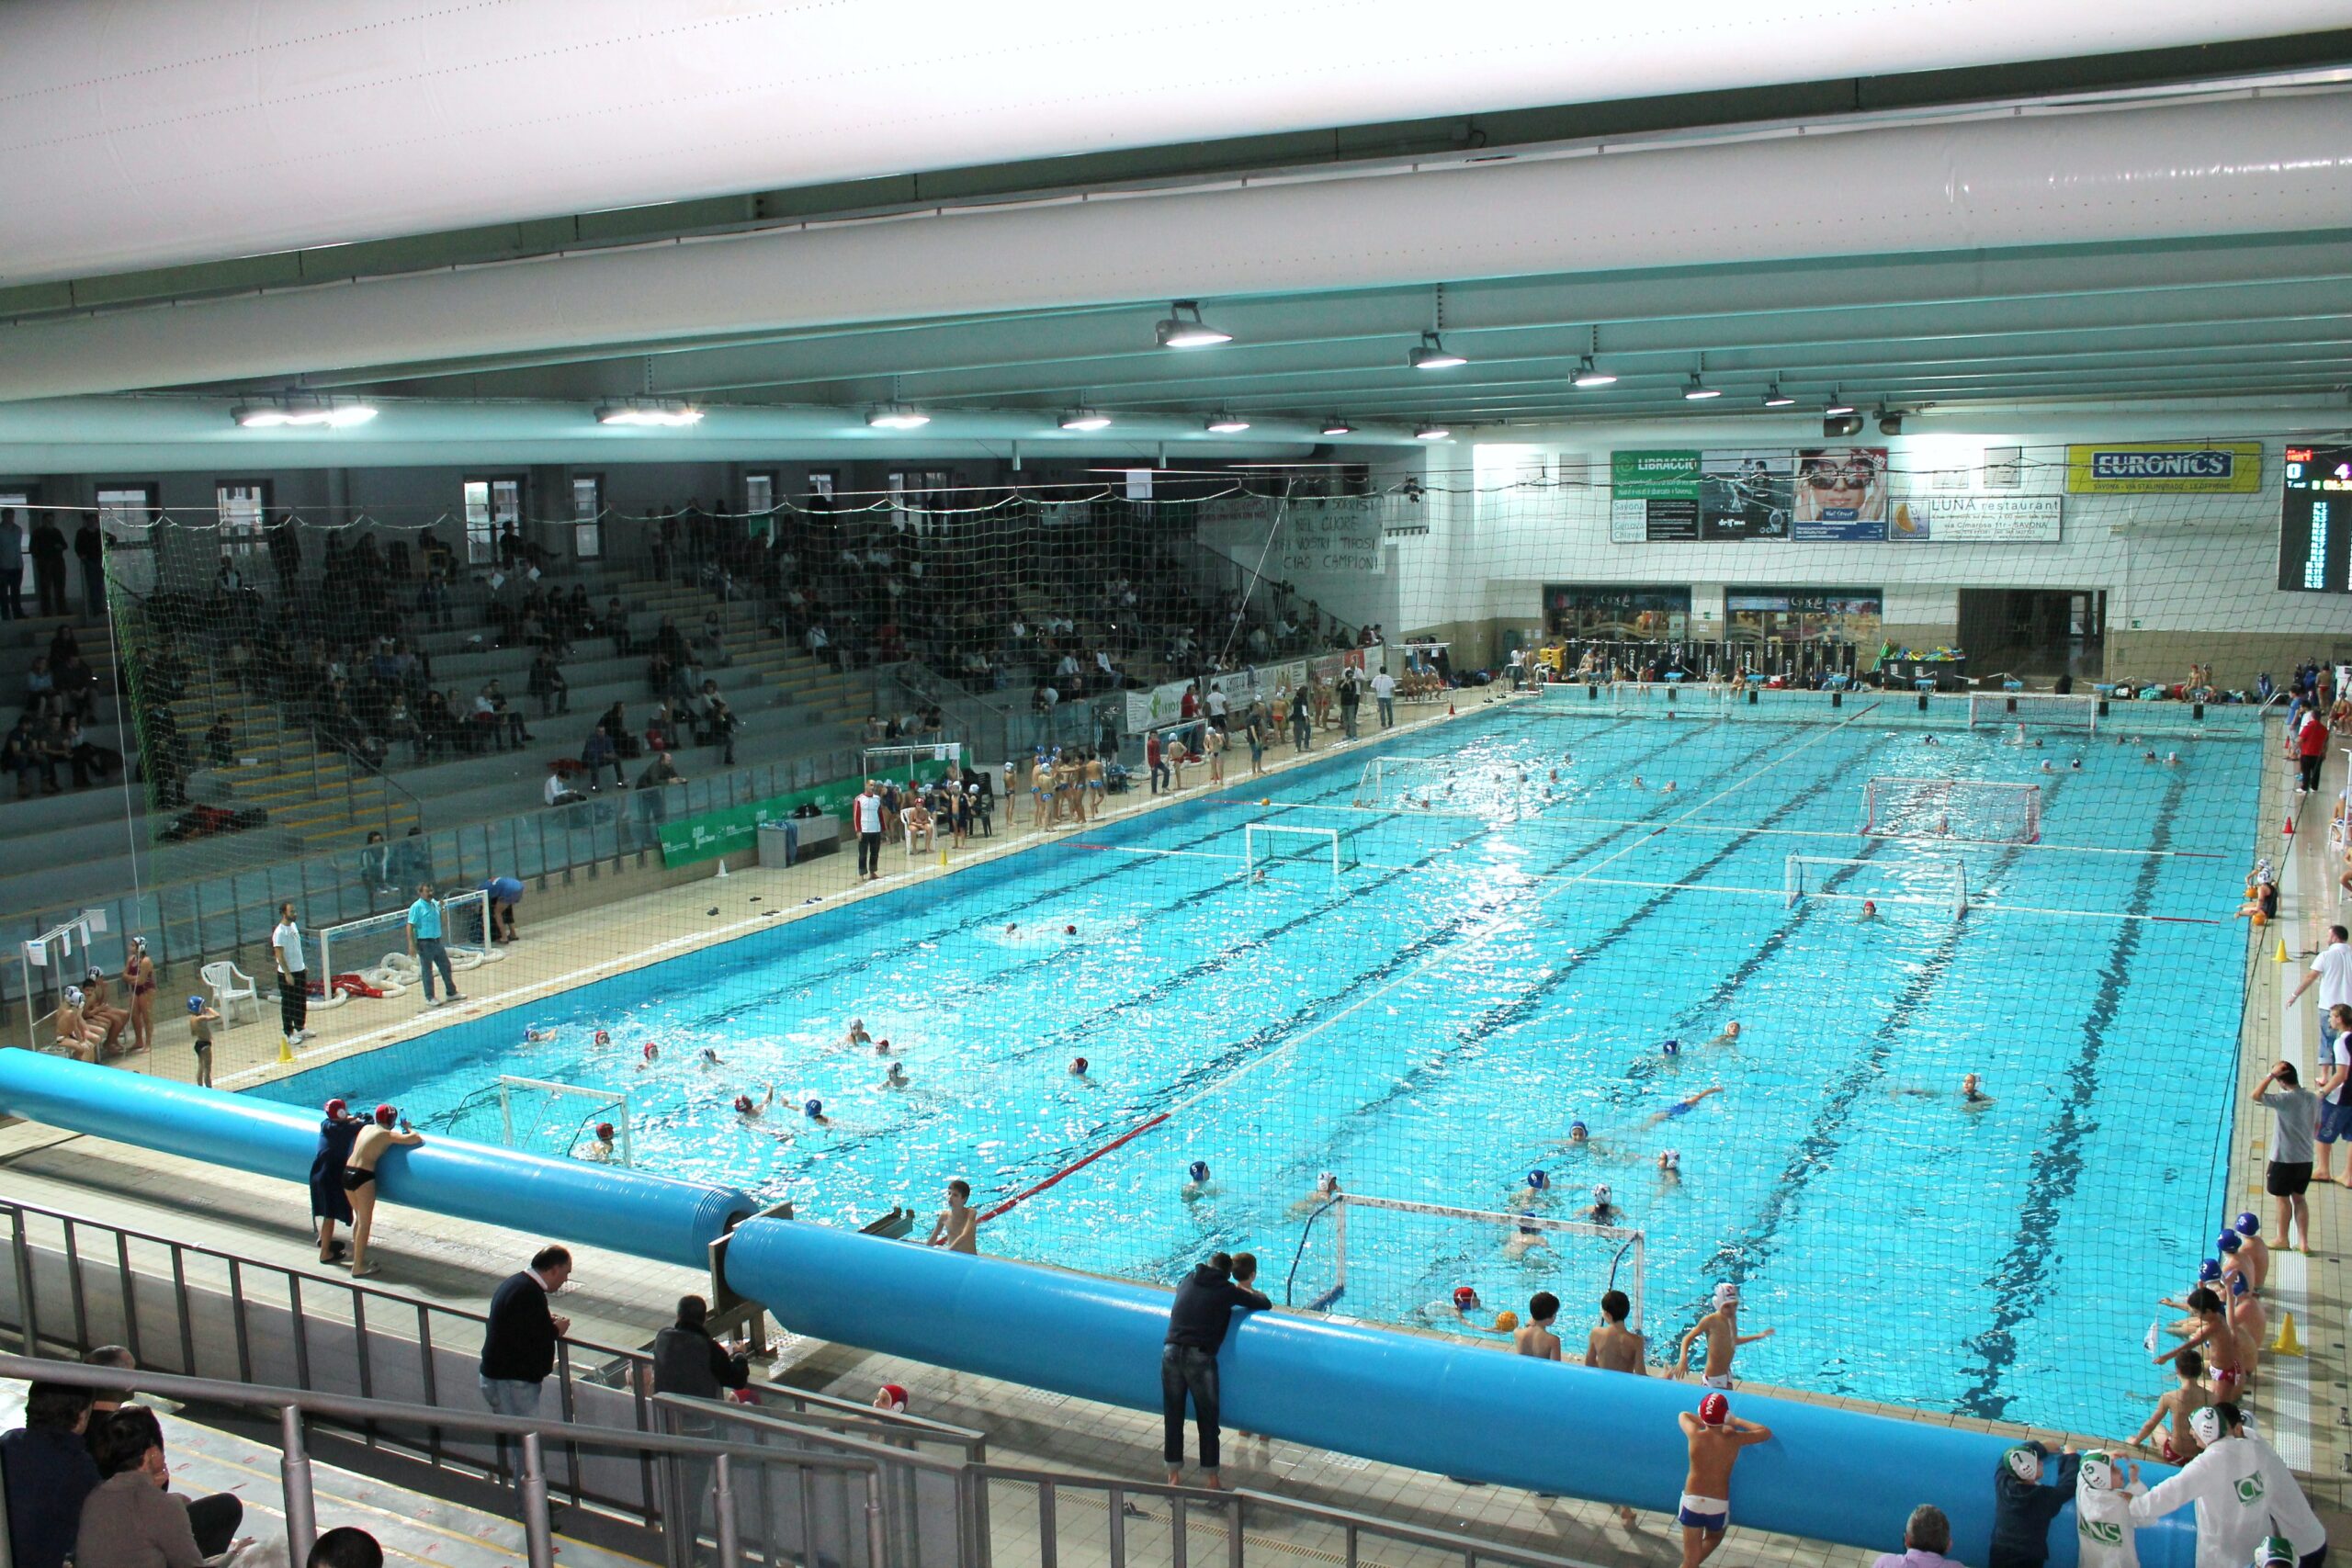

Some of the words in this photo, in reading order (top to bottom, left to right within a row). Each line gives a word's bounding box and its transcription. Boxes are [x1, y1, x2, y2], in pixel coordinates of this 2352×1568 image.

[1637, 457, 1697, 470] LIBRACCIO
[2098, 454, 2224, 474] EURONICS
[2334, 463, 2350, 479] 4
[1614, 502, 1645, 511] Savona
[1931, 499, 1976, 511] LUNA
[1981, 501, 2058, 511] restaurant
[1321, 515, 1359, 531] CUORE
[1297, 536, 1329, 550] VOSTRI
[1283, 556, 1312, 570] CIAO
[1323, 555, 1378, 570] CAMPIONI
[2205, 1408, 2215, 1419] 3
[2012, 1451, 2023, 1463] 7
[2084, 1463, 2095, 1475] 5
